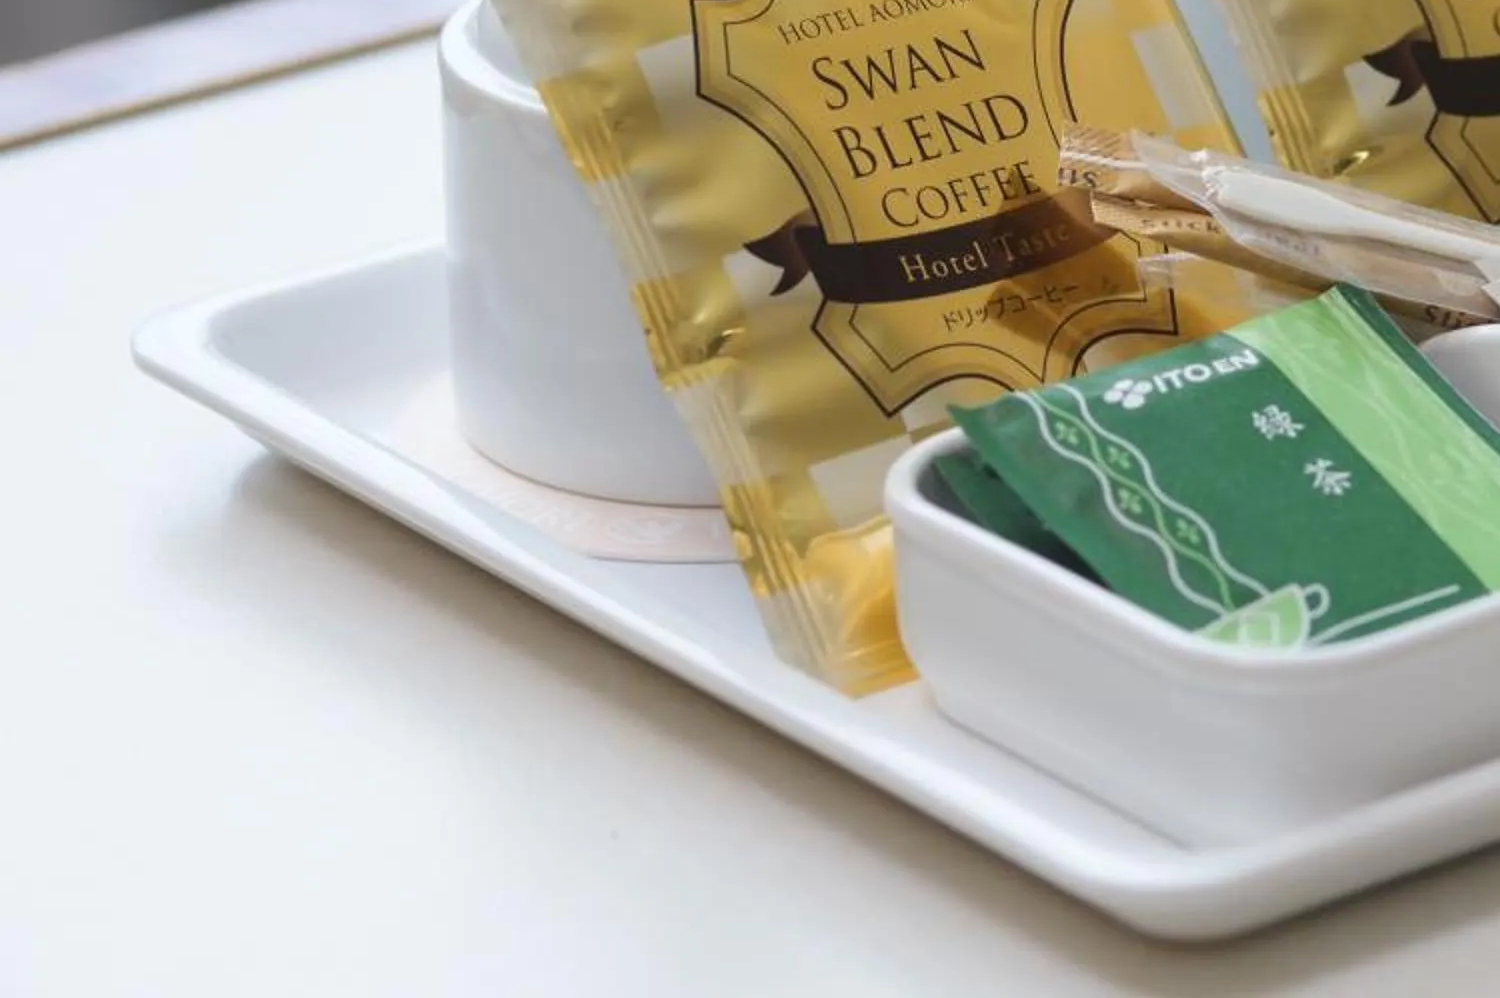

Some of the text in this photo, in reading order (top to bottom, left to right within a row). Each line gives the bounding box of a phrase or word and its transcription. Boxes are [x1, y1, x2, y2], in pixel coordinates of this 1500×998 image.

[778, 5, 864, 45] HOTEL
[811, 28, 986, 111] SWAN
[833, 93, 1030, 179] BLEND
[881, 160, 1042, 229] COFFEE
[898, 223, 1071, 283] Hotel Taste
[942, 284, 1079, 332] ドリップコーヒー
